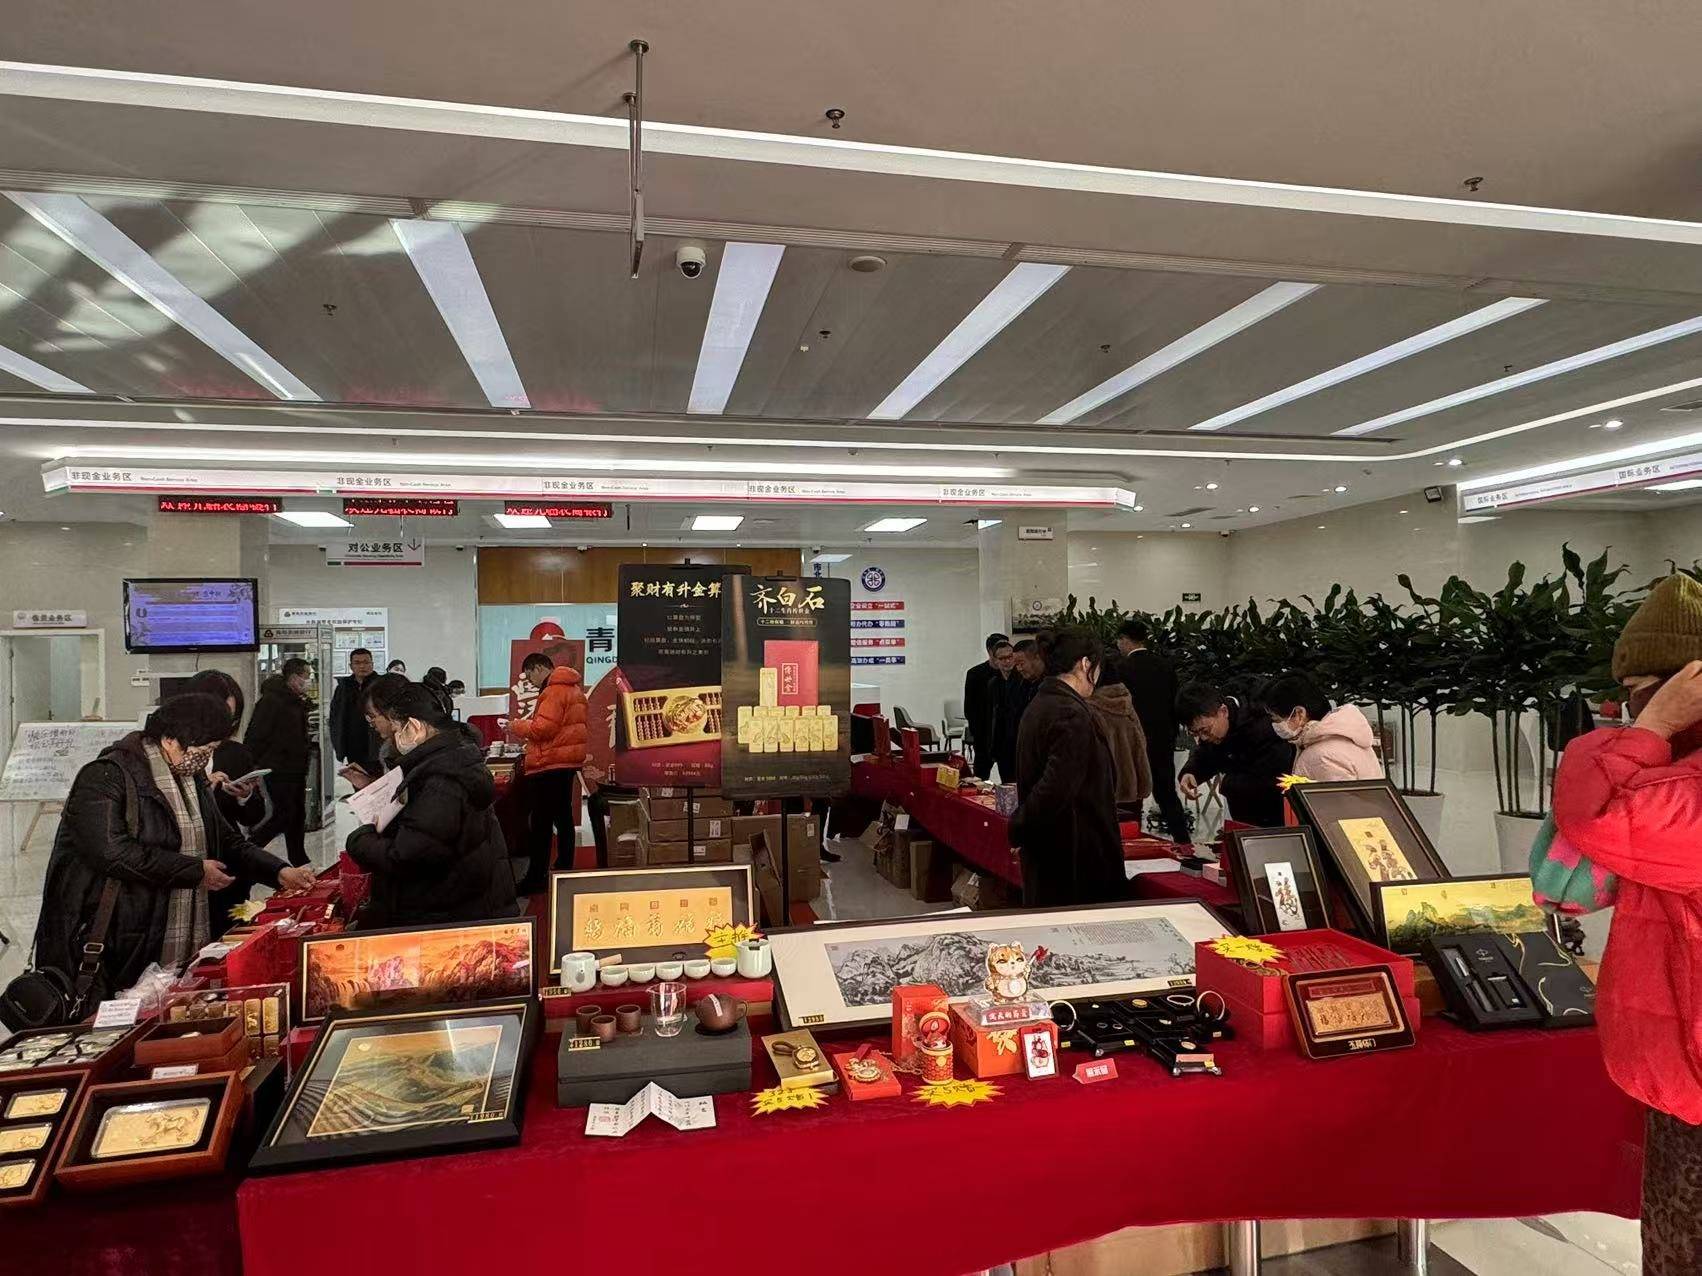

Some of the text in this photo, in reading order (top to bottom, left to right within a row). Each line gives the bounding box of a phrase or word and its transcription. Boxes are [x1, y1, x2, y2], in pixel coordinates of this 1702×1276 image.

[71, 471, 132, 482] 非现金业务区
[336, 477, 392, 487] 非现金业务区
[543, 481, 594, 490] 非现金业务区
[748, 485, 796, 494] 非现金业务区
[348, 542, 404, 553] 对公业务区
[630, 581, 722, 599] 聚财有升金算
[749, 584, 825, 615] 齐白石
[585, 627, 615, 653] 青
